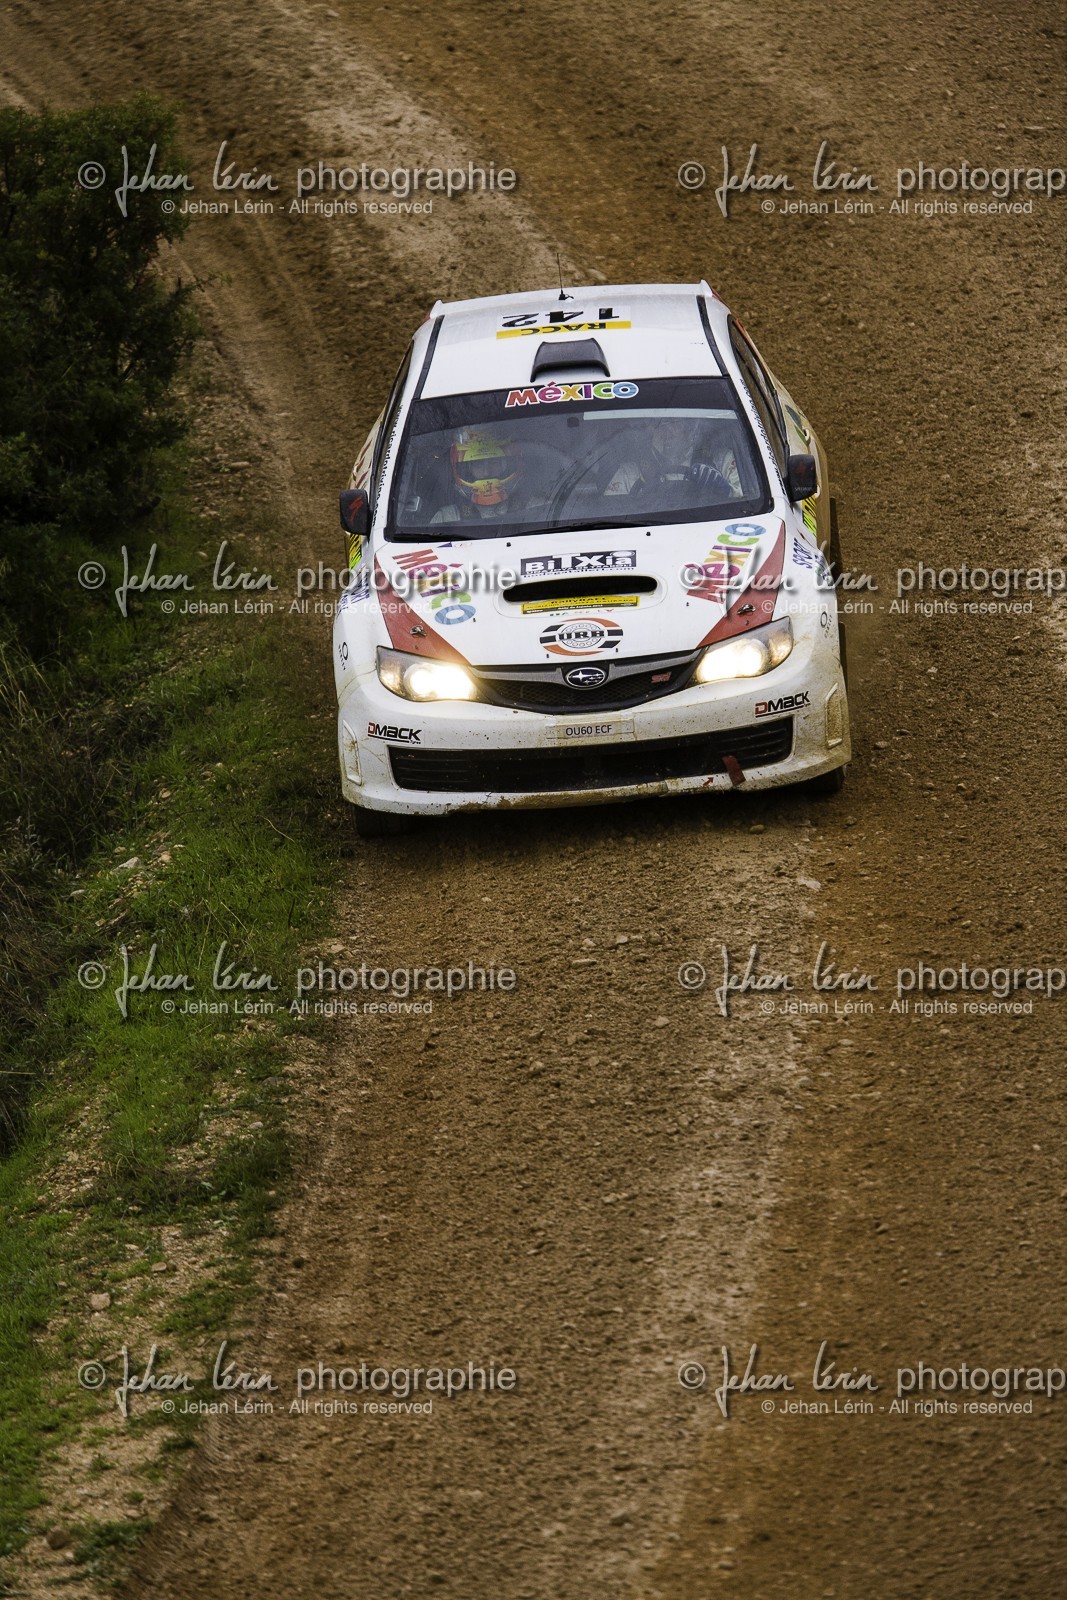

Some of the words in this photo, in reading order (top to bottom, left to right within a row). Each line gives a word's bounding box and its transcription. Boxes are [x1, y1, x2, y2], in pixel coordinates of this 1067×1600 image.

[502, 307, 620, 328] 142
[520, 322, 607, 336] RACC
[565, 725, 593, 736] OU60
[595, 724, 612, 734] ECF
